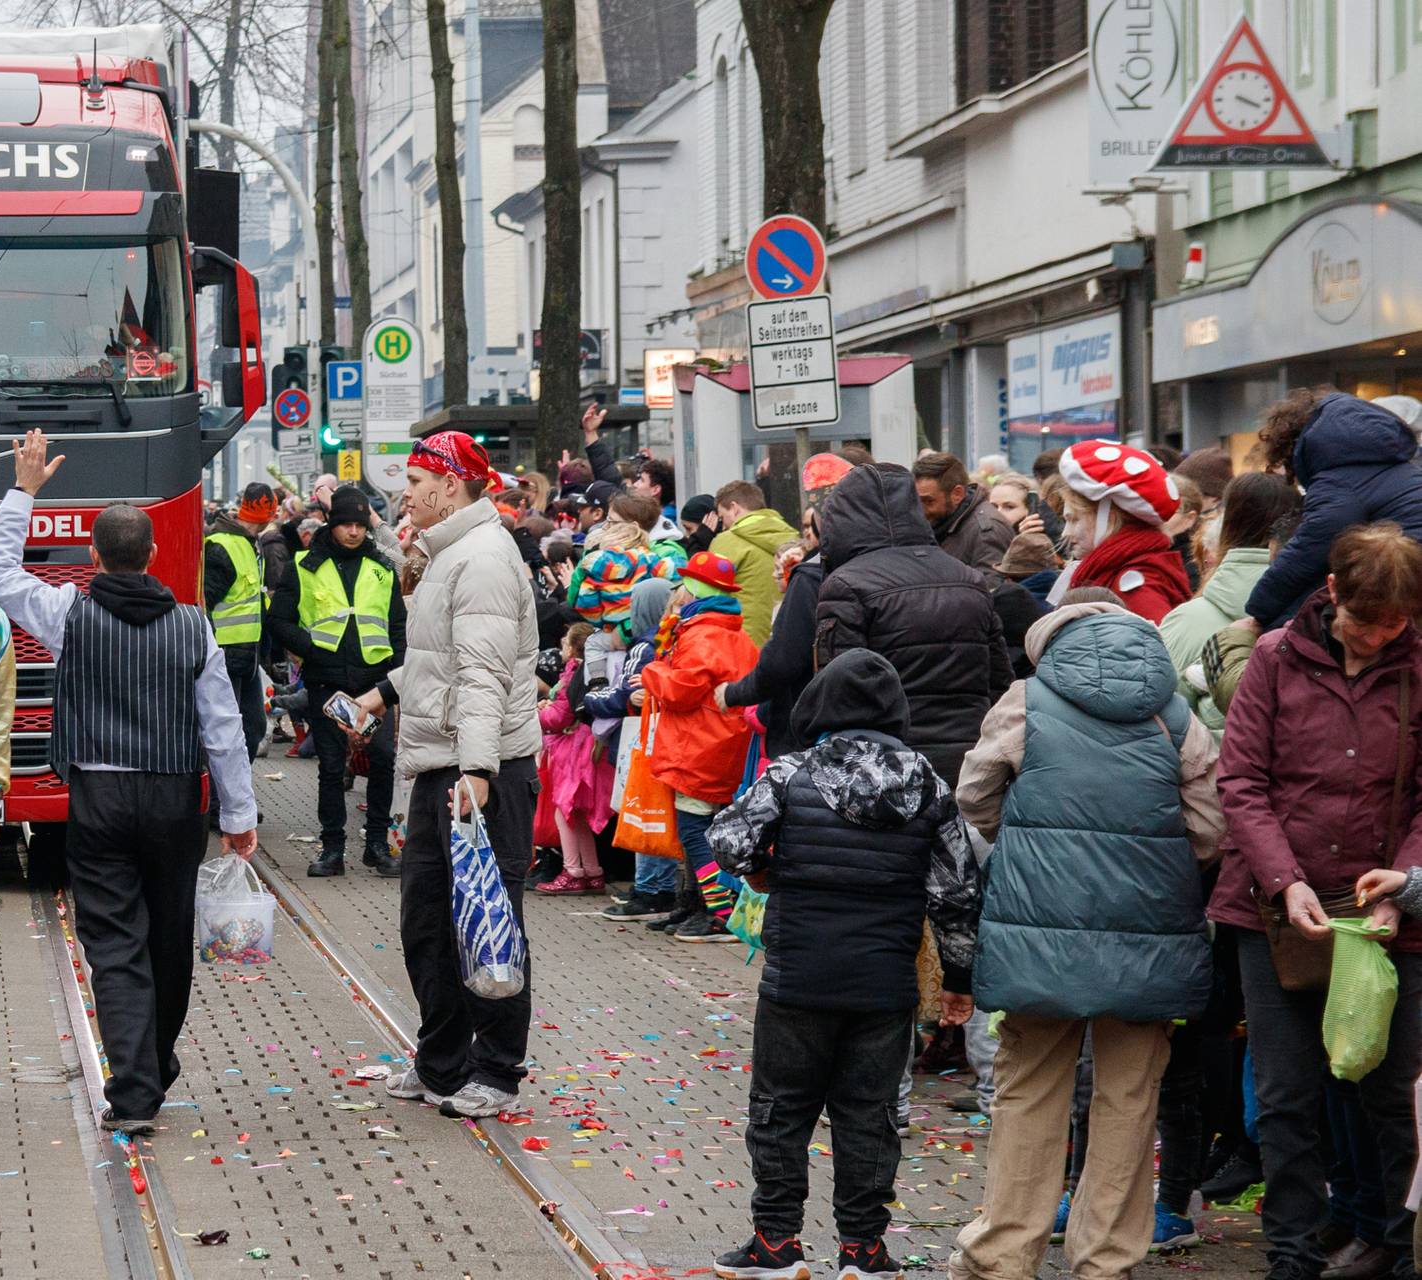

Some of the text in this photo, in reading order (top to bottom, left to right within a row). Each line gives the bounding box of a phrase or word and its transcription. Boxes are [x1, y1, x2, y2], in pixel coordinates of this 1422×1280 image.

[1101, 139, 1163, 157] BRILLE
[771, 309, 809, 324] auf dem
[758, 322, 824, 341] Seitenstreifen
[384, 335, 401, 356] H
[771, 346, 813, 361] werktags
[777, 365, 782, 379] 7
[793, 362, 810, 377] 18h
[336, 366, 360, 398] P
[774, 401, 818, 416] Ladezone
